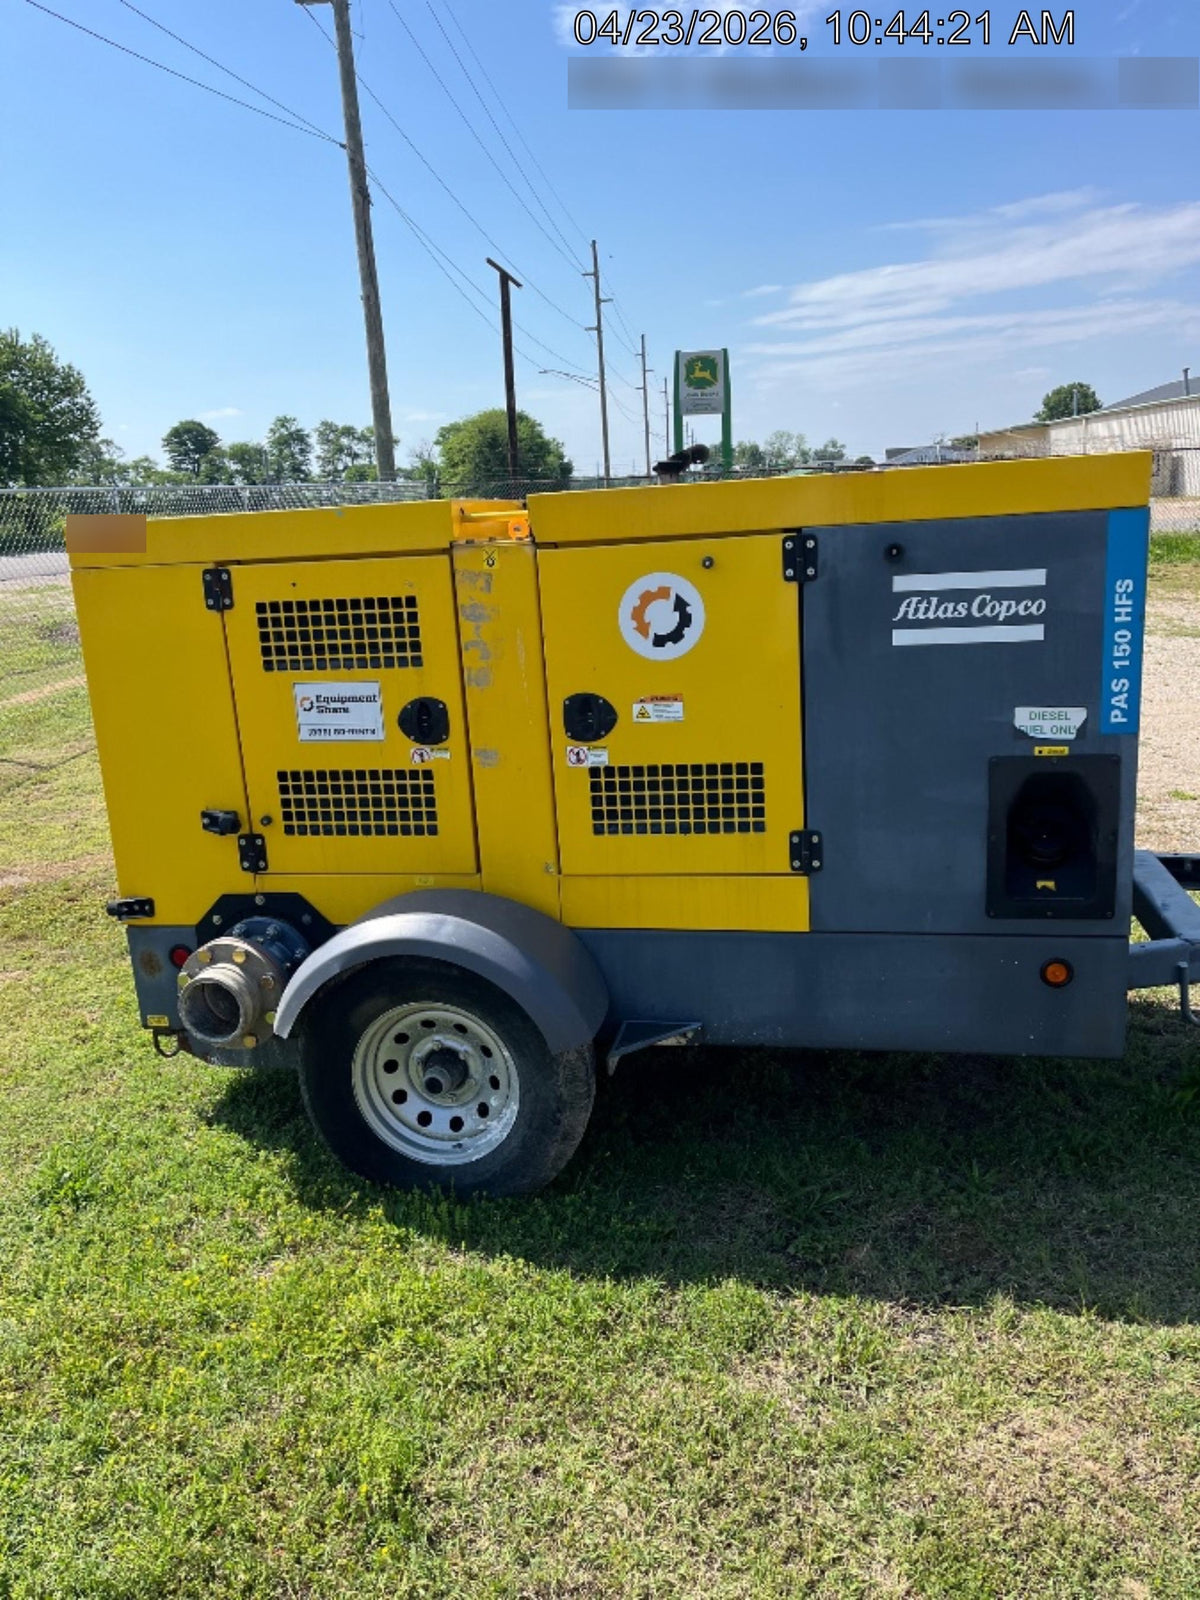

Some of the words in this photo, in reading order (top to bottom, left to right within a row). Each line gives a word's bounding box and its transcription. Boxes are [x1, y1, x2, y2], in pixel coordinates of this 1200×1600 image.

[893, 597, 968, 621] Atlas
[971, 594, 1047, 621] Copco
[1114, 579, 1134, 623] HFS
[1113, 629, 1132, 669] 150
[315, 694, 377, 704] Equipment
[315, 705, 350, 714] Share
[1110, 678, 1130, 723] PAS
[1029, 710, 1071, 721] DIESEL
